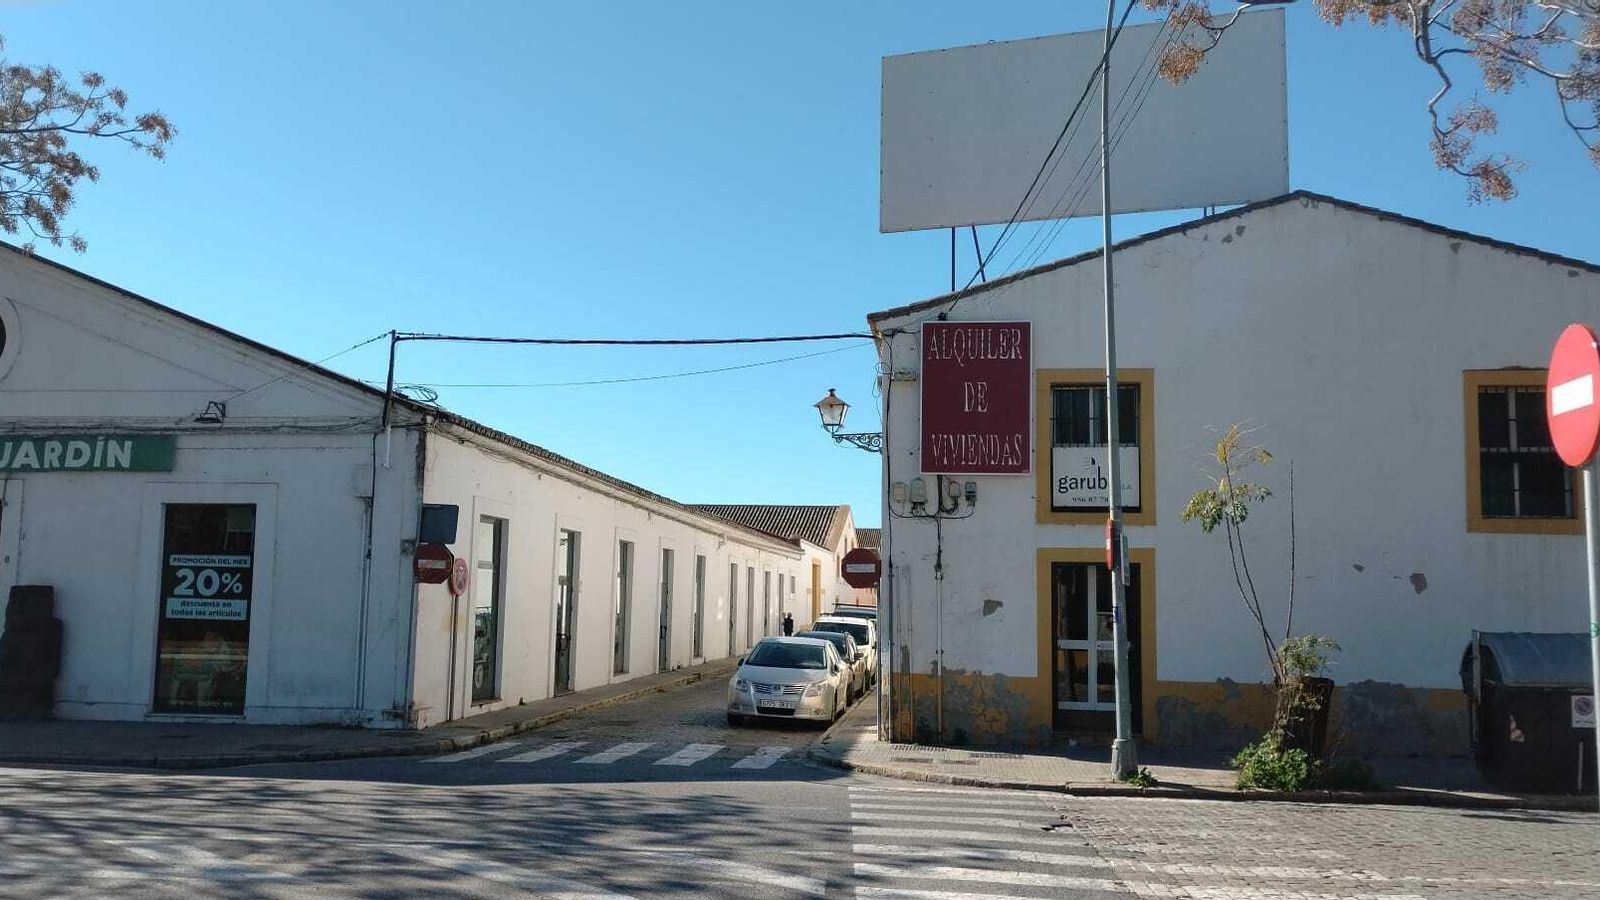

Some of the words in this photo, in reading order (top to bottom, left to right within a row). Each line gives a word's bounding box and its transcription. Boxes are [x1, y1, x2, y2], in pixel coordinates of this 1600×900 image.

[928, 328, 1023, 367] ALQUILER
[964, 381, 989, 413] DE
[0, 436, 133, 468] JARDÍN
[931, 433, 1023, 467] VIVIENDAS
[1058, 465, 1109, 493] garub
[172, 556, 217, 565] PROMOCIÓN
[217, 557, 230, 565] DEL
[232, 558, 248, 566] MES
[173, 568, 243, 596] 20%
[171, 608, 193, 617] todos
[195, 608, 207, 617] los
[180, 600, 220, 608] descuento
